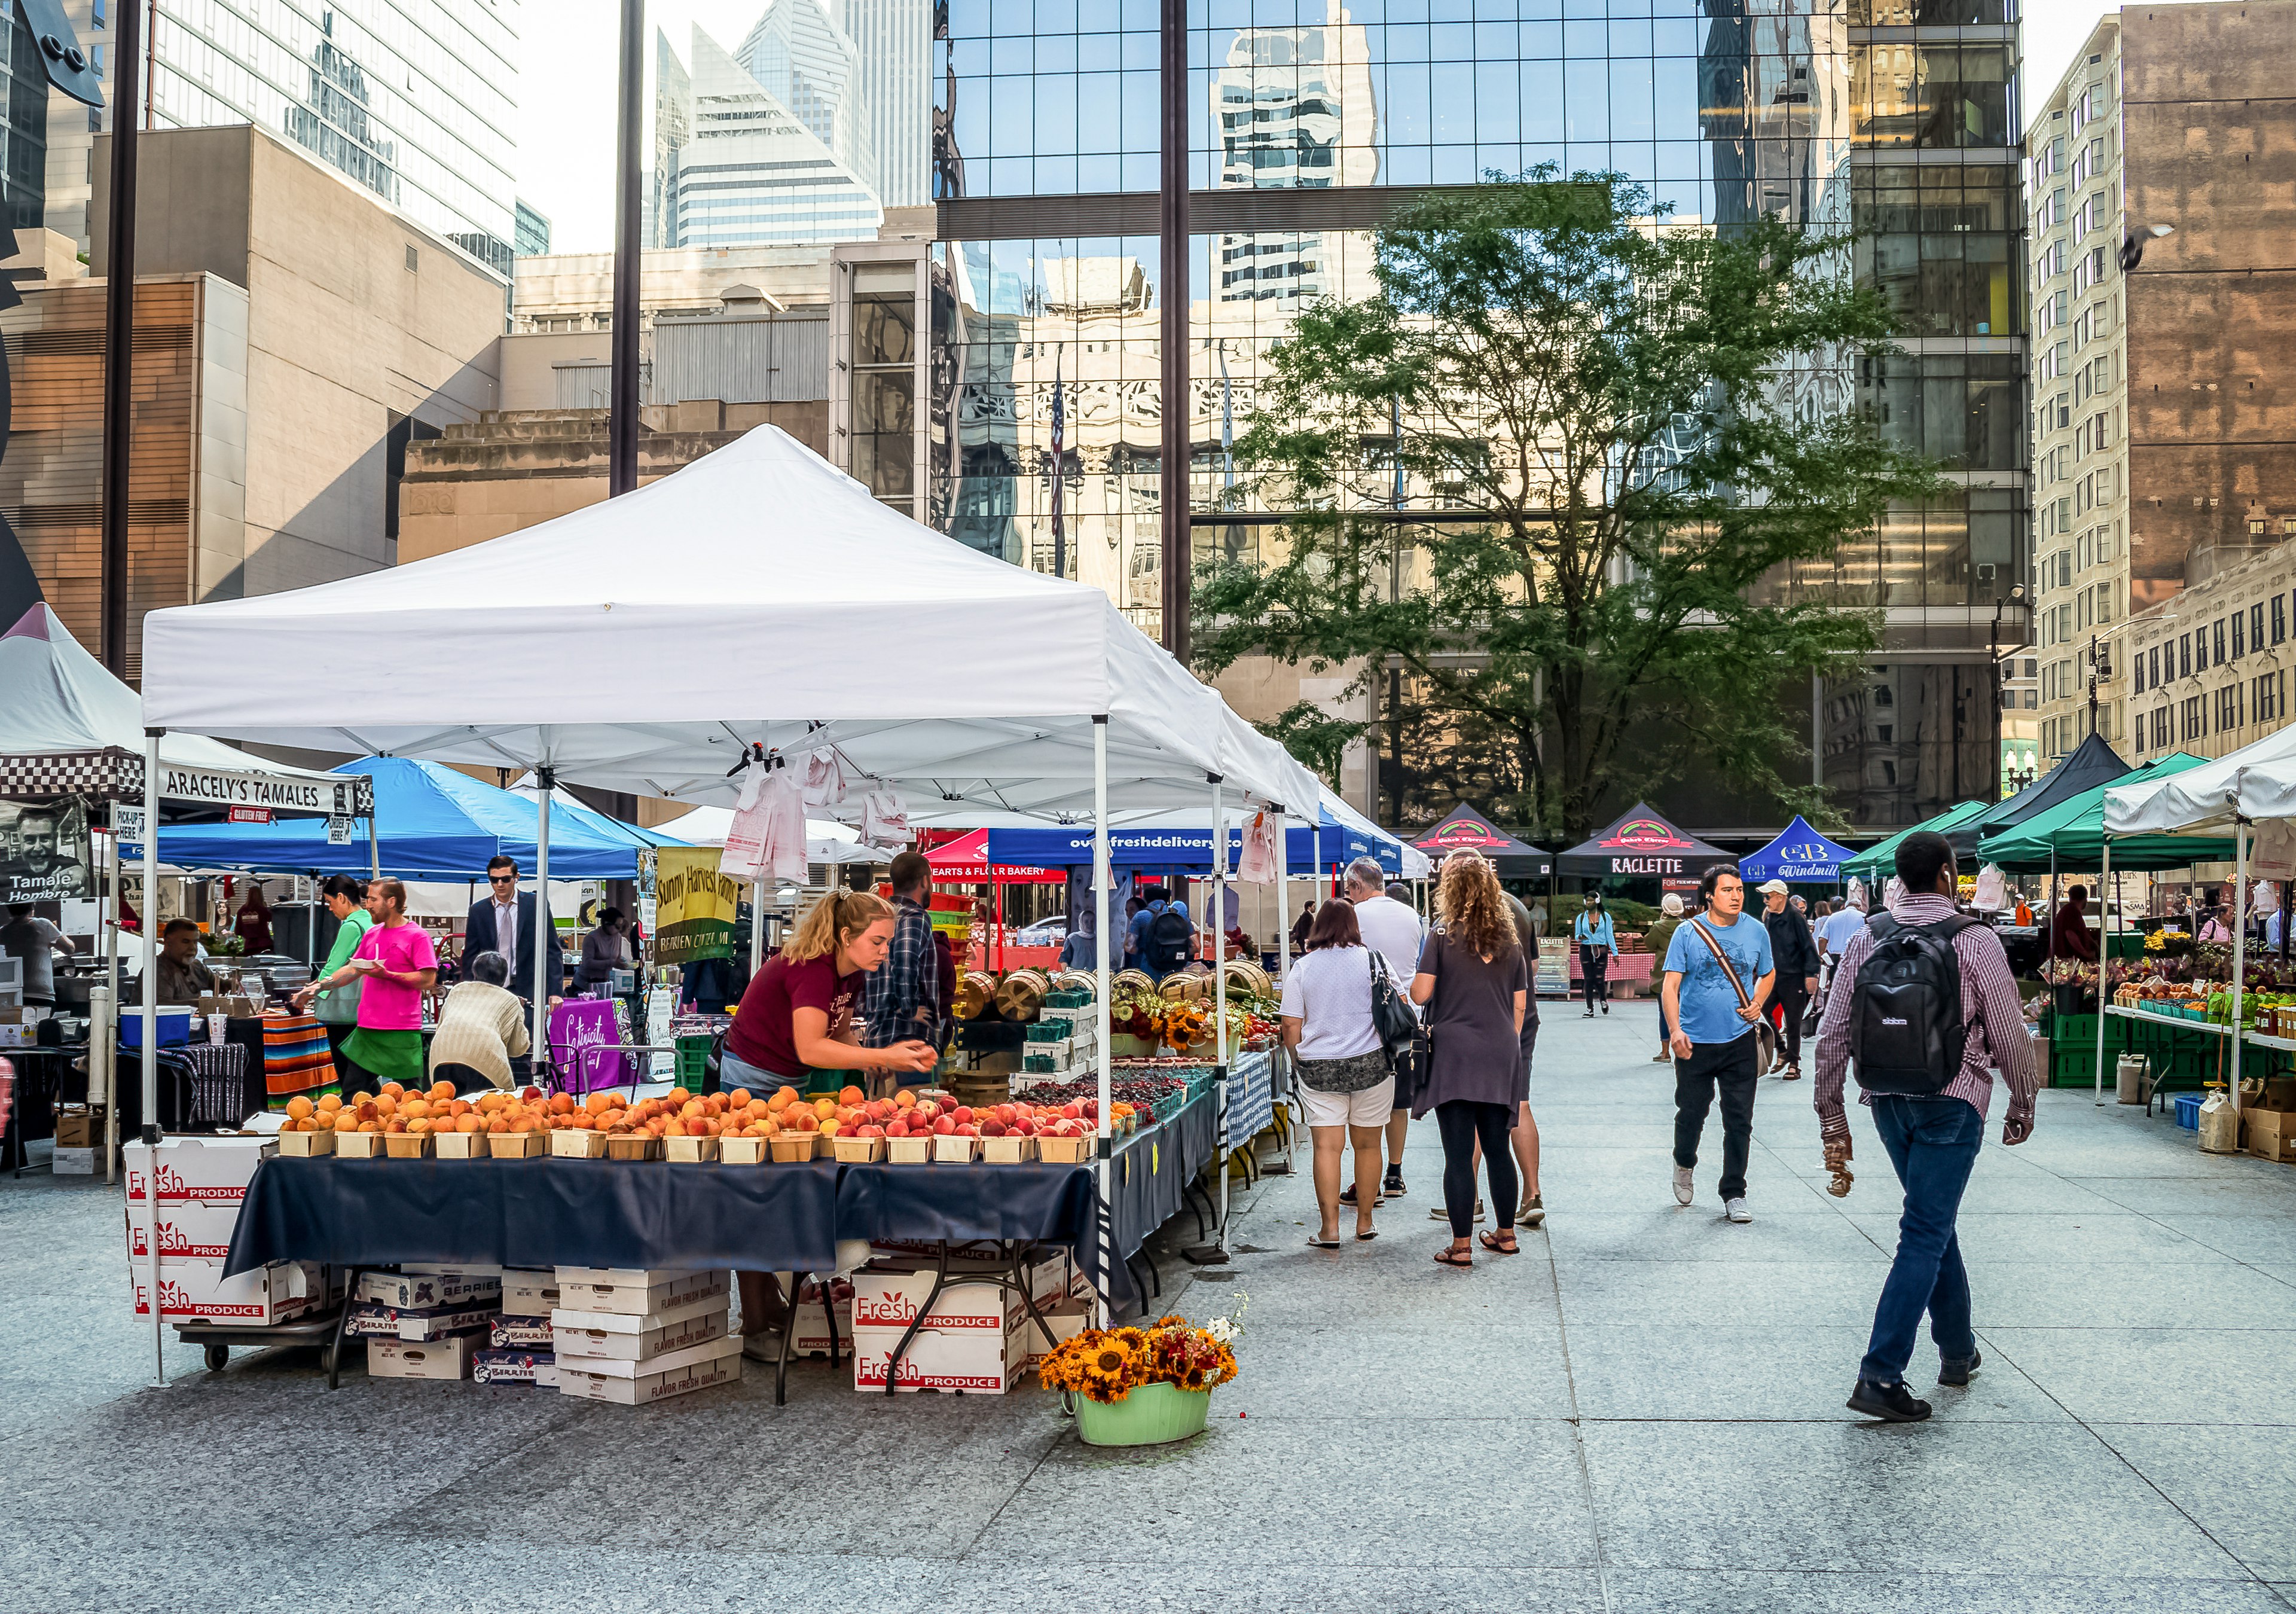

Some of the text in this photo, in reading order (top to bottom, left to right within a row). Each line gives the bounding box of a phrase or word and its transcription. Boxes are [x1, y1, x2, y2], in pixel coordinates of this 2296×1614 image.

[166, 771, 319, 807] ARACELY'S TAMALES
[117, 810, 138, 825] PICK-UP
[234, 808, 268, 821] GLUTEN FREE
[120, 826, 136, 839] HERE
[1007, 867, 1045, 875] BAKERY
[1613, 858, 1683, 873] RACLETTE
[1778, 864, 1839, 878] Windmill
[9, 873, 71, 889] Tamale
[658, 872, 684, 910] Sunny
[686, 864, 716, 894] Harvest
[8, 890, 71, 902] Hombre
[719, 931, 728, 945] MI
[129, 1170, 184, 1191] Frsh
[190, 1189, 246, 1197] PRODUC
[193, 1247, 228, 1256] PROD
[444, 1280, 502, 1296] BERRIES
[136, 1286, 190, 1308] Fesh
[661, 1284, 720, 1310] FLAVOR FRESH QUALITY
[196, 1305, 259, 1315] PRODUCE
[857, 1297, 917, 1319] Fresh
[924, 1317, 995, 1326] PRODUCE
[654, 1326, 716, 1353] FLAVOR FRESH QUALITY
[859, 1357, 918, 1379] Fresh
[651, 1369, 727, 1398] FLAVOR FRESH QUALITY
[925, 1377, 996, 1387] PRODUCE
